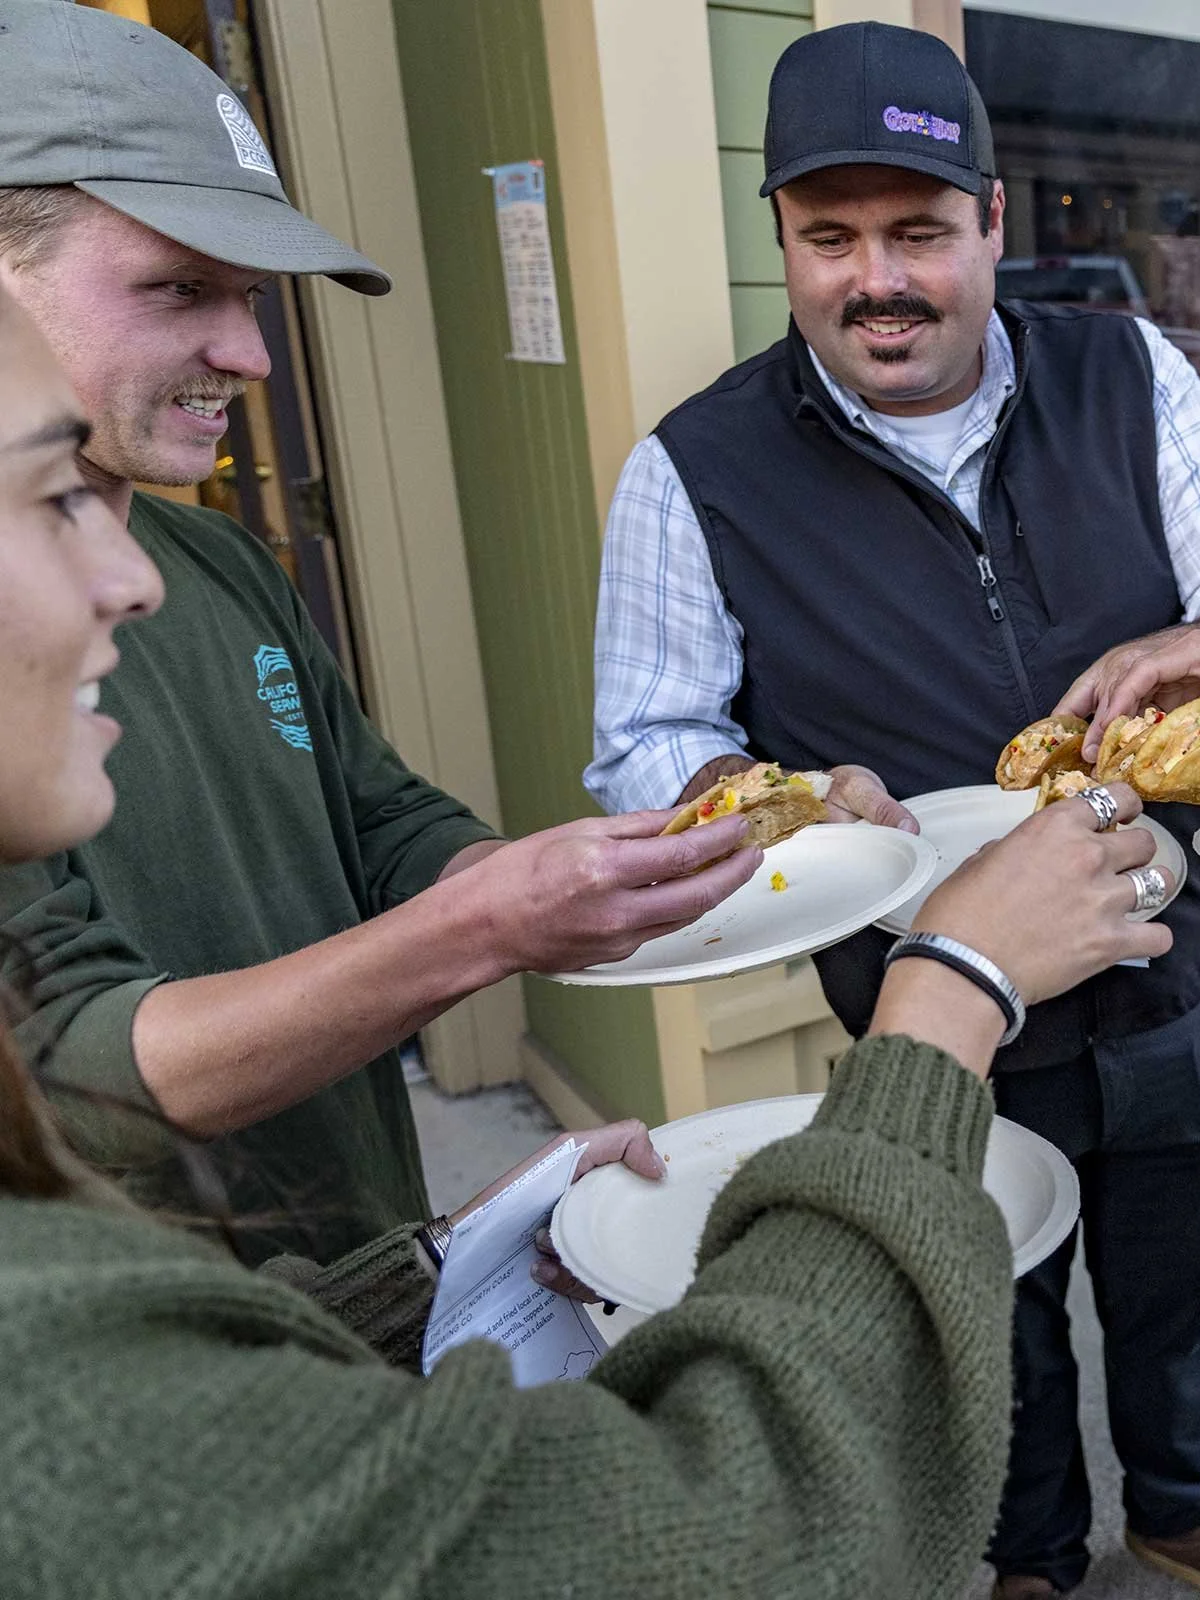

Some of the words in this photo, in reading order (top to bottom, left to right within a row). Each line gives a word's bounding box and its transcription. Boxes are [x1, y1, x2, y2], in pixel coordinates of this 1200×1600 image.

[468, 1286, 491, 1309] NORTH
[491, 1266, 514, 1289] COAST
[460, 1312, 473, 1327] CO
[491, 1317, 504, 1332] and
[503, 1303, 519, 1322] fried
[516, 1294, 533, 1311] local
[501, 1320, 525, 1341] tortilla,
[523, 1303, 544, 1323] topped
[543, 1291, 557, 1307] with
[520, 1328, 532, 1344] and
[535, 1311, 555, 1331] daikon
